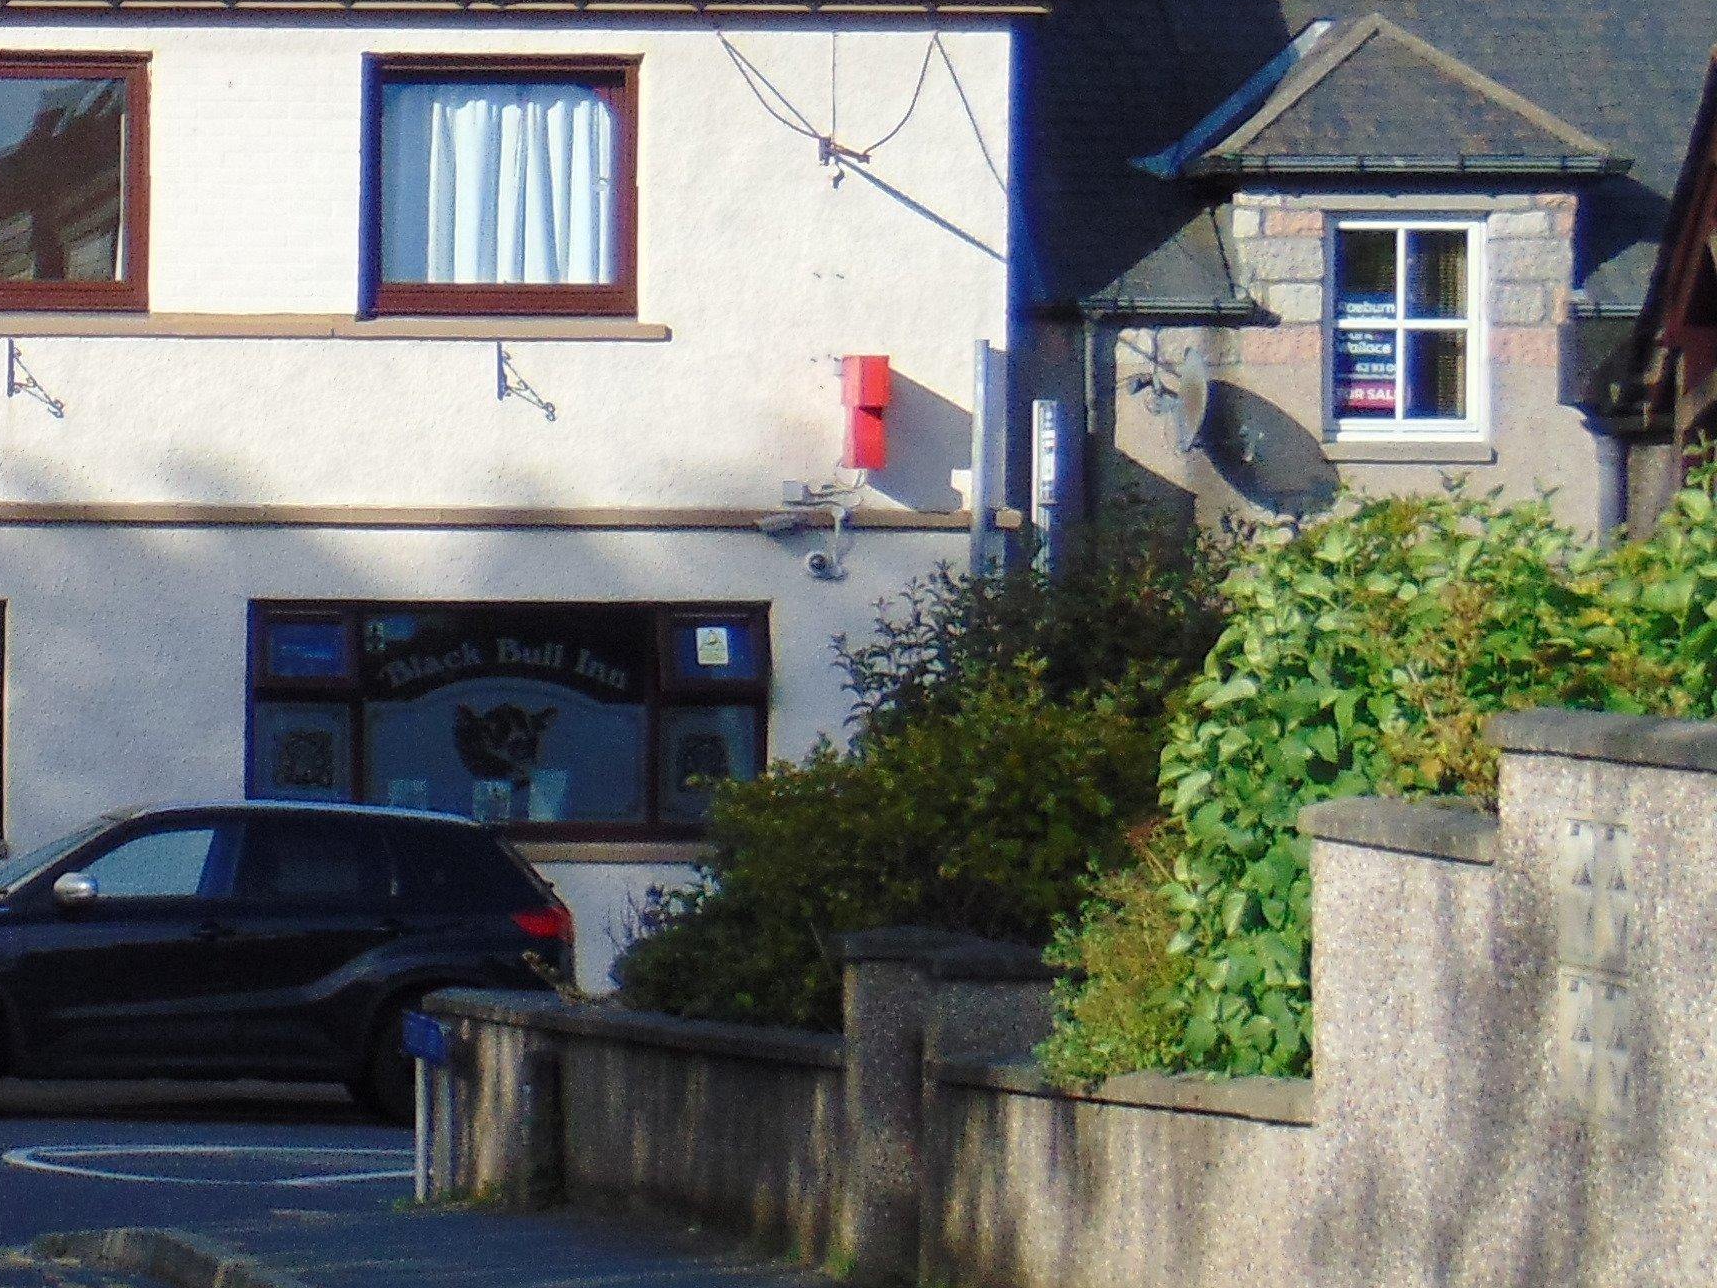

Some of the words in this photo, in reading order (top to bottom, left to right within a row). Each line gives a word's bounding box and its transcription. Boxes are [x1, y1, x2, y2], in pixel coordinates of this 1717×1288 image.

[1367, 387, 1397, 400] SAL
[376, 641, 482, 689] Black
[496, 637, 564, 668] Bull
[573, 647, 629, 691] Inn
